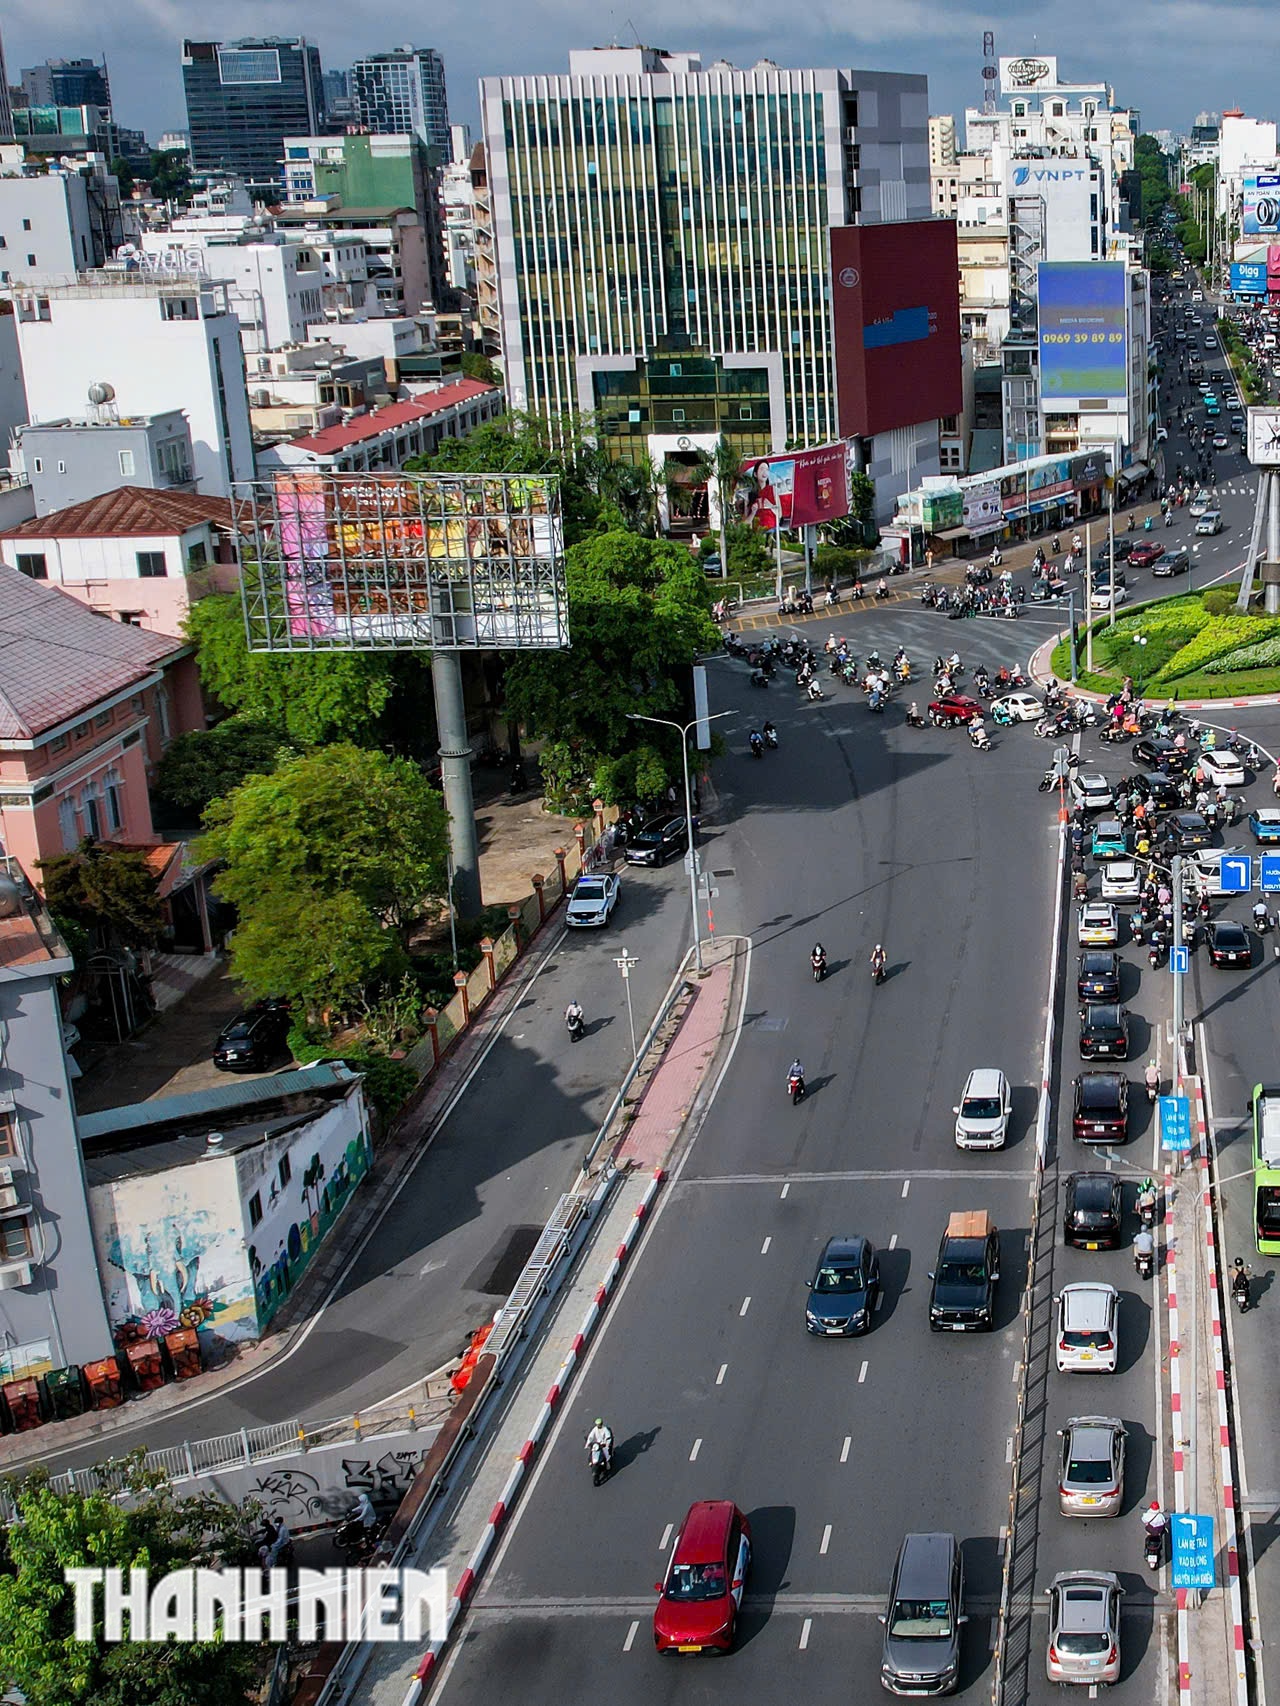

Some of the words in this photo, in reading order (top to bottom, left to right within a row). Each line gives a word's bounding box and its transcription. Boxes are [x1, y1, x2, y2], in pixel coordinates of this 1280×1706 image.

[1033, 170, 1085, 181] VNPT
[1042, 334, 1071, 343] 0969
[1074, 333, 1088, 343] 39
[1091, 333, 1106, 343] 89
[1108, 333, 1123, 343] 89
